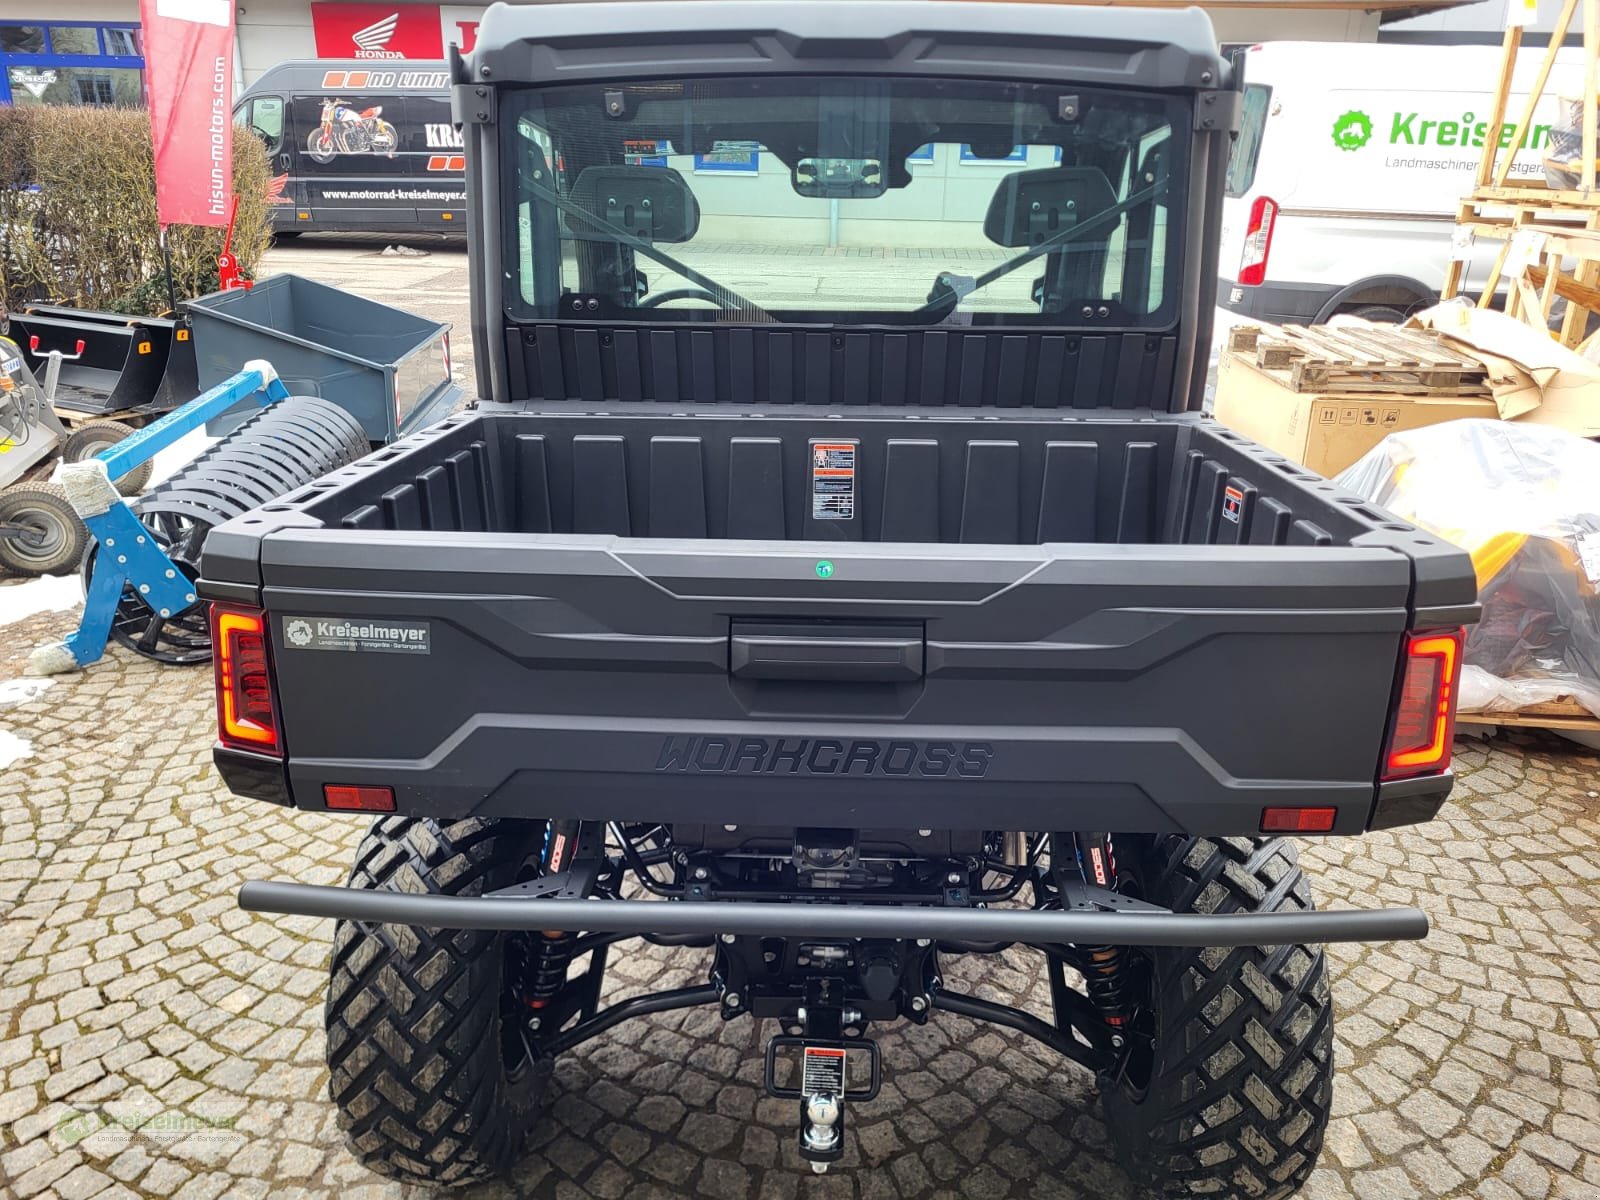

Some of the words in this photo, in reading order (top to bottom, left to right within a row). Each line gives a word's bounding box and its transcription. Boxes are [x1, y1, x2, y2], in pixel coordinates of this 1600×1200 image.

[354, 50, 406, 59] HONDA
[367, 72, 396, 88] NO
[209, 56, 226, 215] hisun-motors.com
[317, 622, 426, 642] Kreiselmeyer
[655, 735, 994, 778] WORKCROSS
